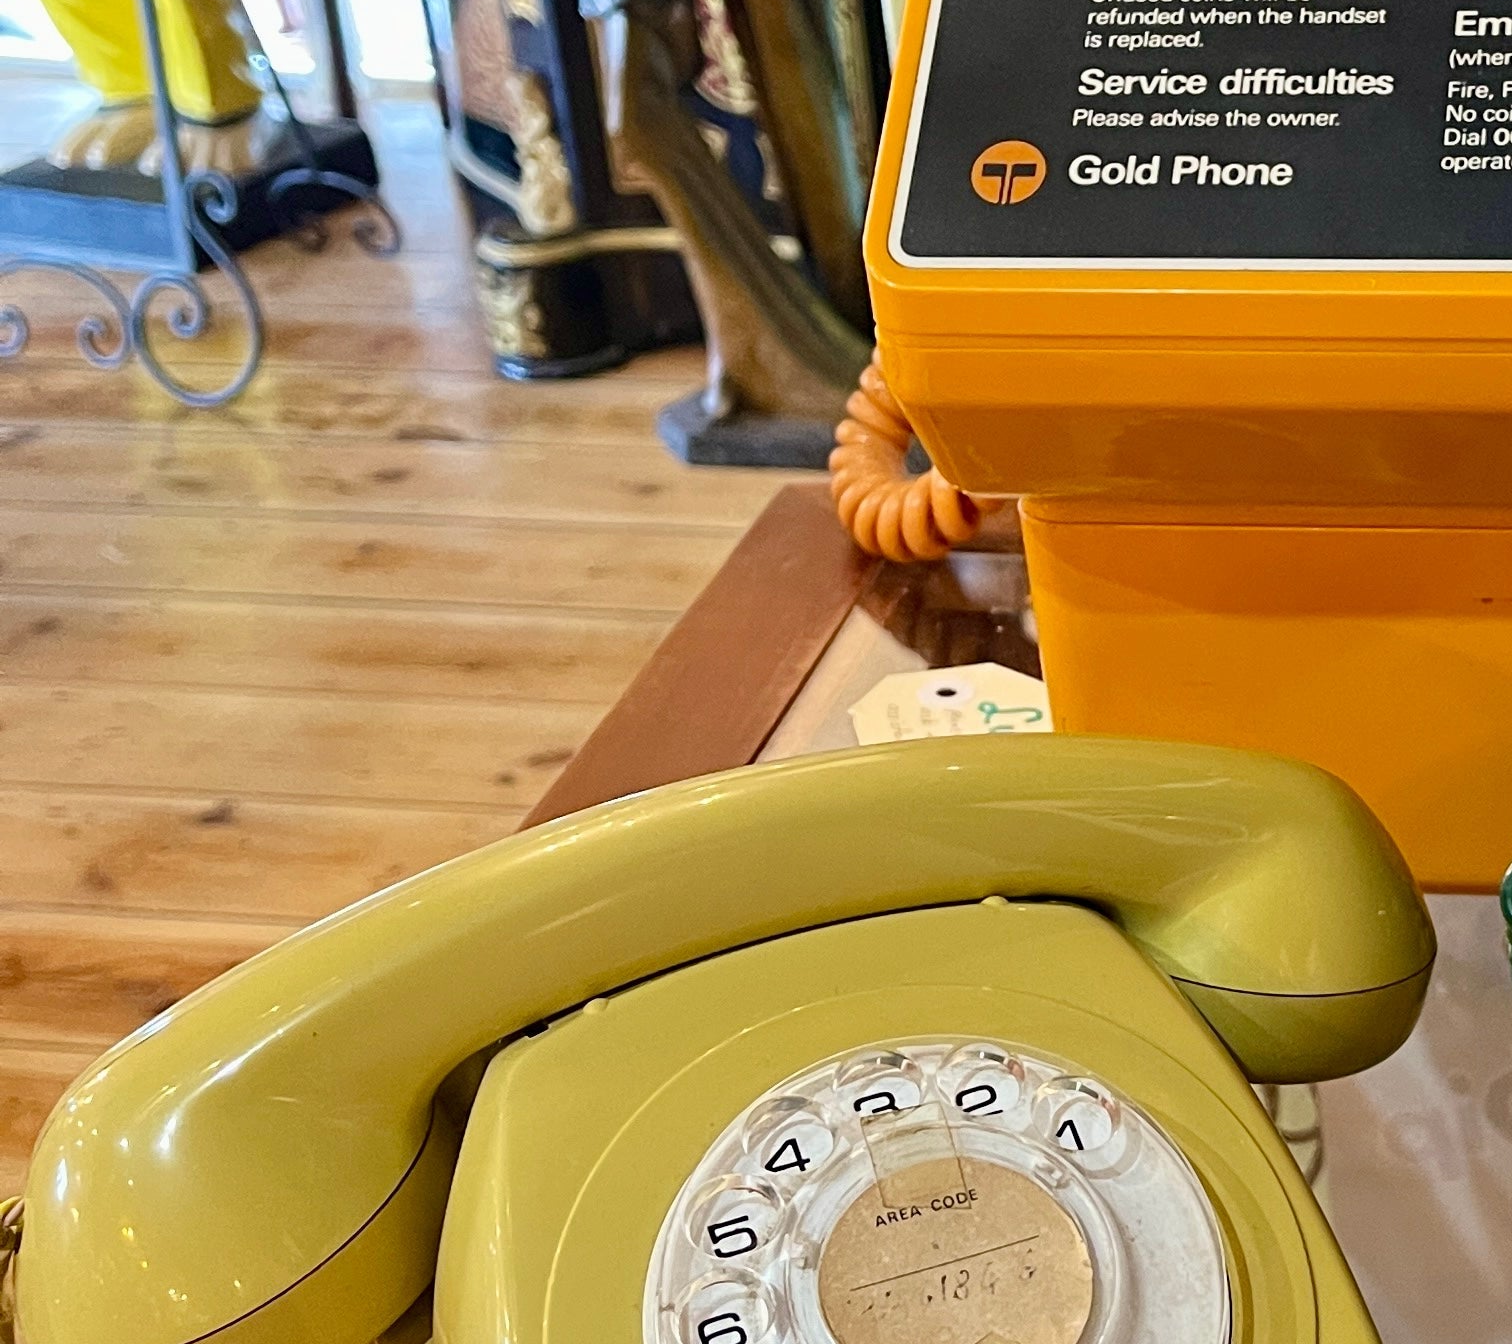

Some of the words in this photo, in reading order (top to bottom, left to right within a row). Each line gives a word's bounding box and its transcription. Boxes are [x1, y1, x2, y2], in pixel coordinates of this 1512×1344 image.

[1086, 7, 1185, 26] refunded
[1189, 7, 1252, 25] when
[1257, 6, 1294, 25] the
[1298, 6, 1387, 25] handset
[1077, 67, 1208, 96] Service
[1218, 67, 1395, 96] difficulties
[1447, 80, 1495, 101] Fire,
[1072, 108, 1145, 128] Please
[1149, 108, 1220, 128] advise
[1224, 108, 1262, 128] the
[1266, 112, 1341, 127] owner.
[1445, 103, 1478, 123] No
[1443, 127, 1487, 147] Dial
[1068, 154, 1161, 186] Gold
[1171, 155, 1294, 187] Phone
[1055, 1118, 1087, 1152] 1
[764, 1137, 811, 1173] 4
[874, 1205, 922, 1228] AREA
[930, 1188, 979, 1212] CODE
[707, 1215, 758, 1259] 5
